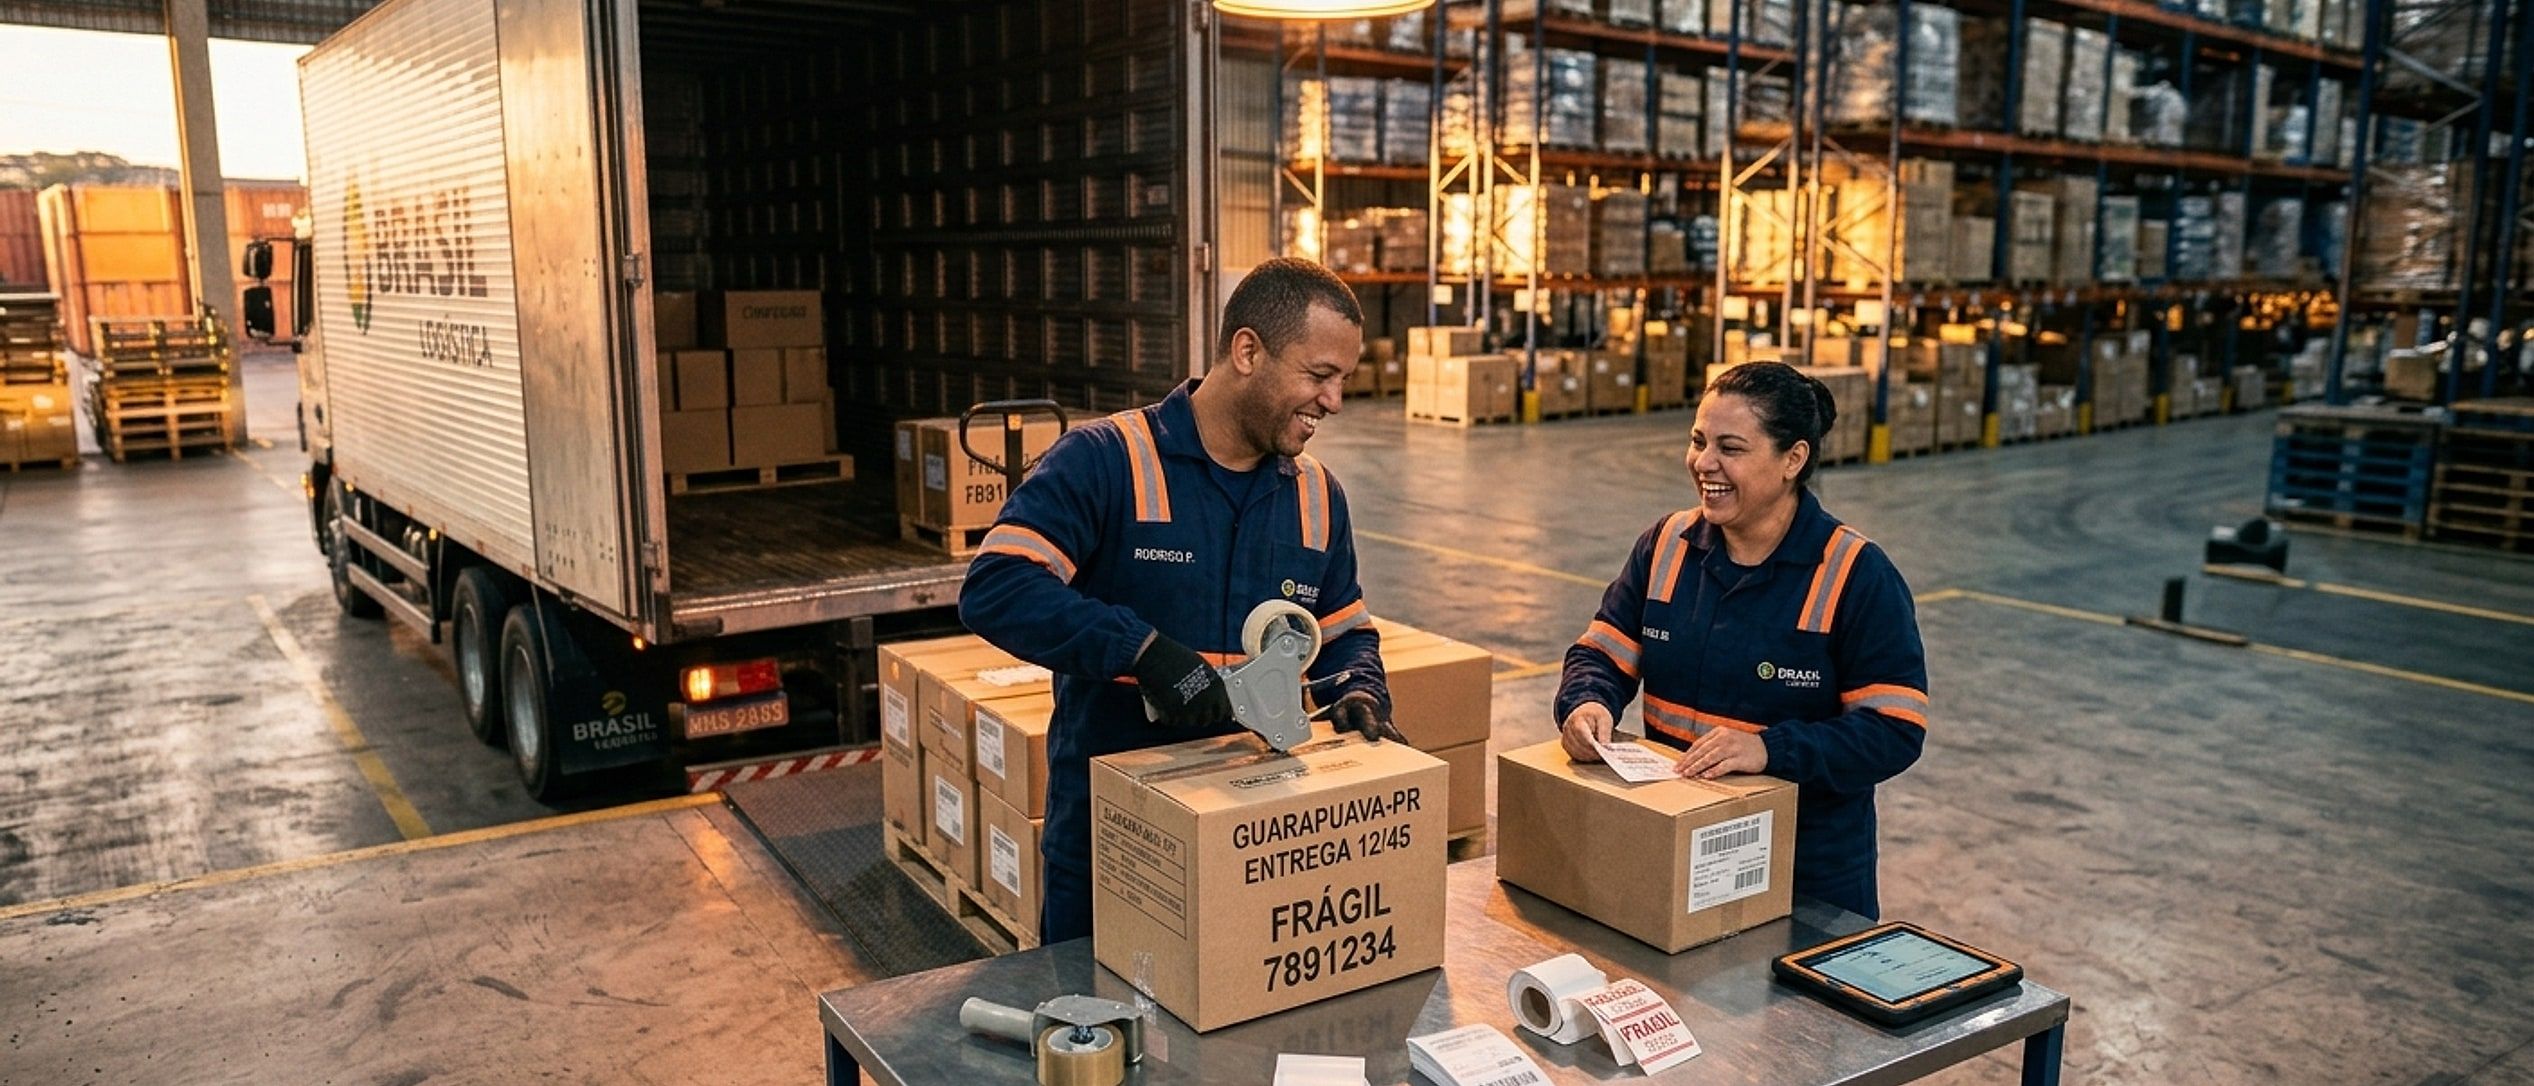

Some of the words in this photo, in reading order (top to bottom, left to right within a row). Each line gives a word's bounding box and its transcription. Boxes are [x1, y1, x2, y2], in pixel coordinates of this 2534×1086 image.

[374, 184, 488, 298] BRASIL
[573, 712, 657, 741] BRASIL
[1233, 787, 1420, 849] GUARAPUAVA-PR
[1245, 838, 1351, 884] ENTREGA
[1358, 824, 1411, 857] 12/45
[1272, 882, 1391, 942] FRÁGIL
[1263, 925, 1396, 992] 7891234
